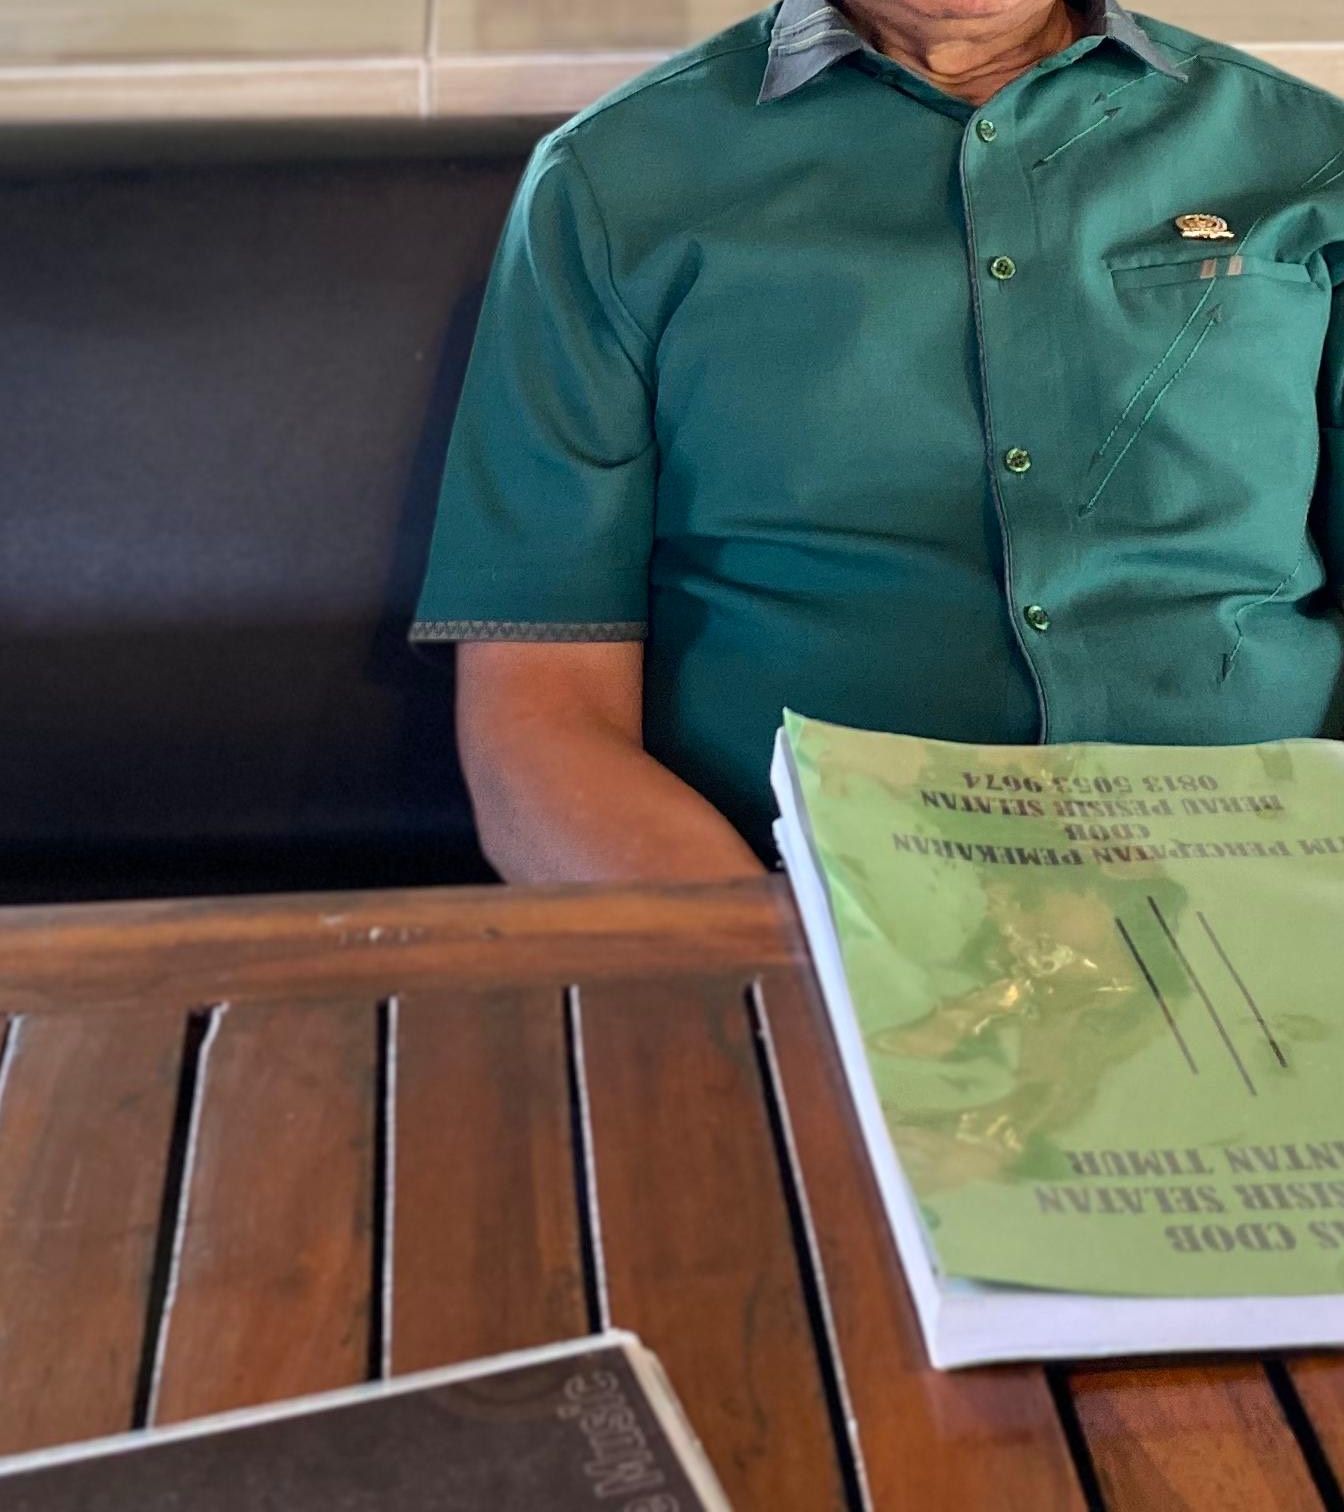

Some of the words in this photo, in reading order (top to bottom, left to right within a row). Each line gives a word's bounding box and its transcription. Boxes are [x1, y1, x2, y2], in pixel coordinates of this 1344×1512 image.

[962, 771, 1043, 792] 9674
[1054, 774, 1132, 794] 5053
[1144, 774, 1219, 791] 0813
[921, 790, 1045, 818] SELATAN
[1055, 799, 1175, 818] PESISIR
[1183, 795, 1284, 815] BERAU
[1065, 823, 1150, 842] CDOB
[892, 832, 1084, 865] PEMEKARAN
[1093, 839, 1291, 864] PERCEPATAN
[1067, 1148, 1213, 1177] TIMUR
[1033, 1185, 1224, 1215] SELATAN
[1165, 1222, 1297, 1252] CDOB
